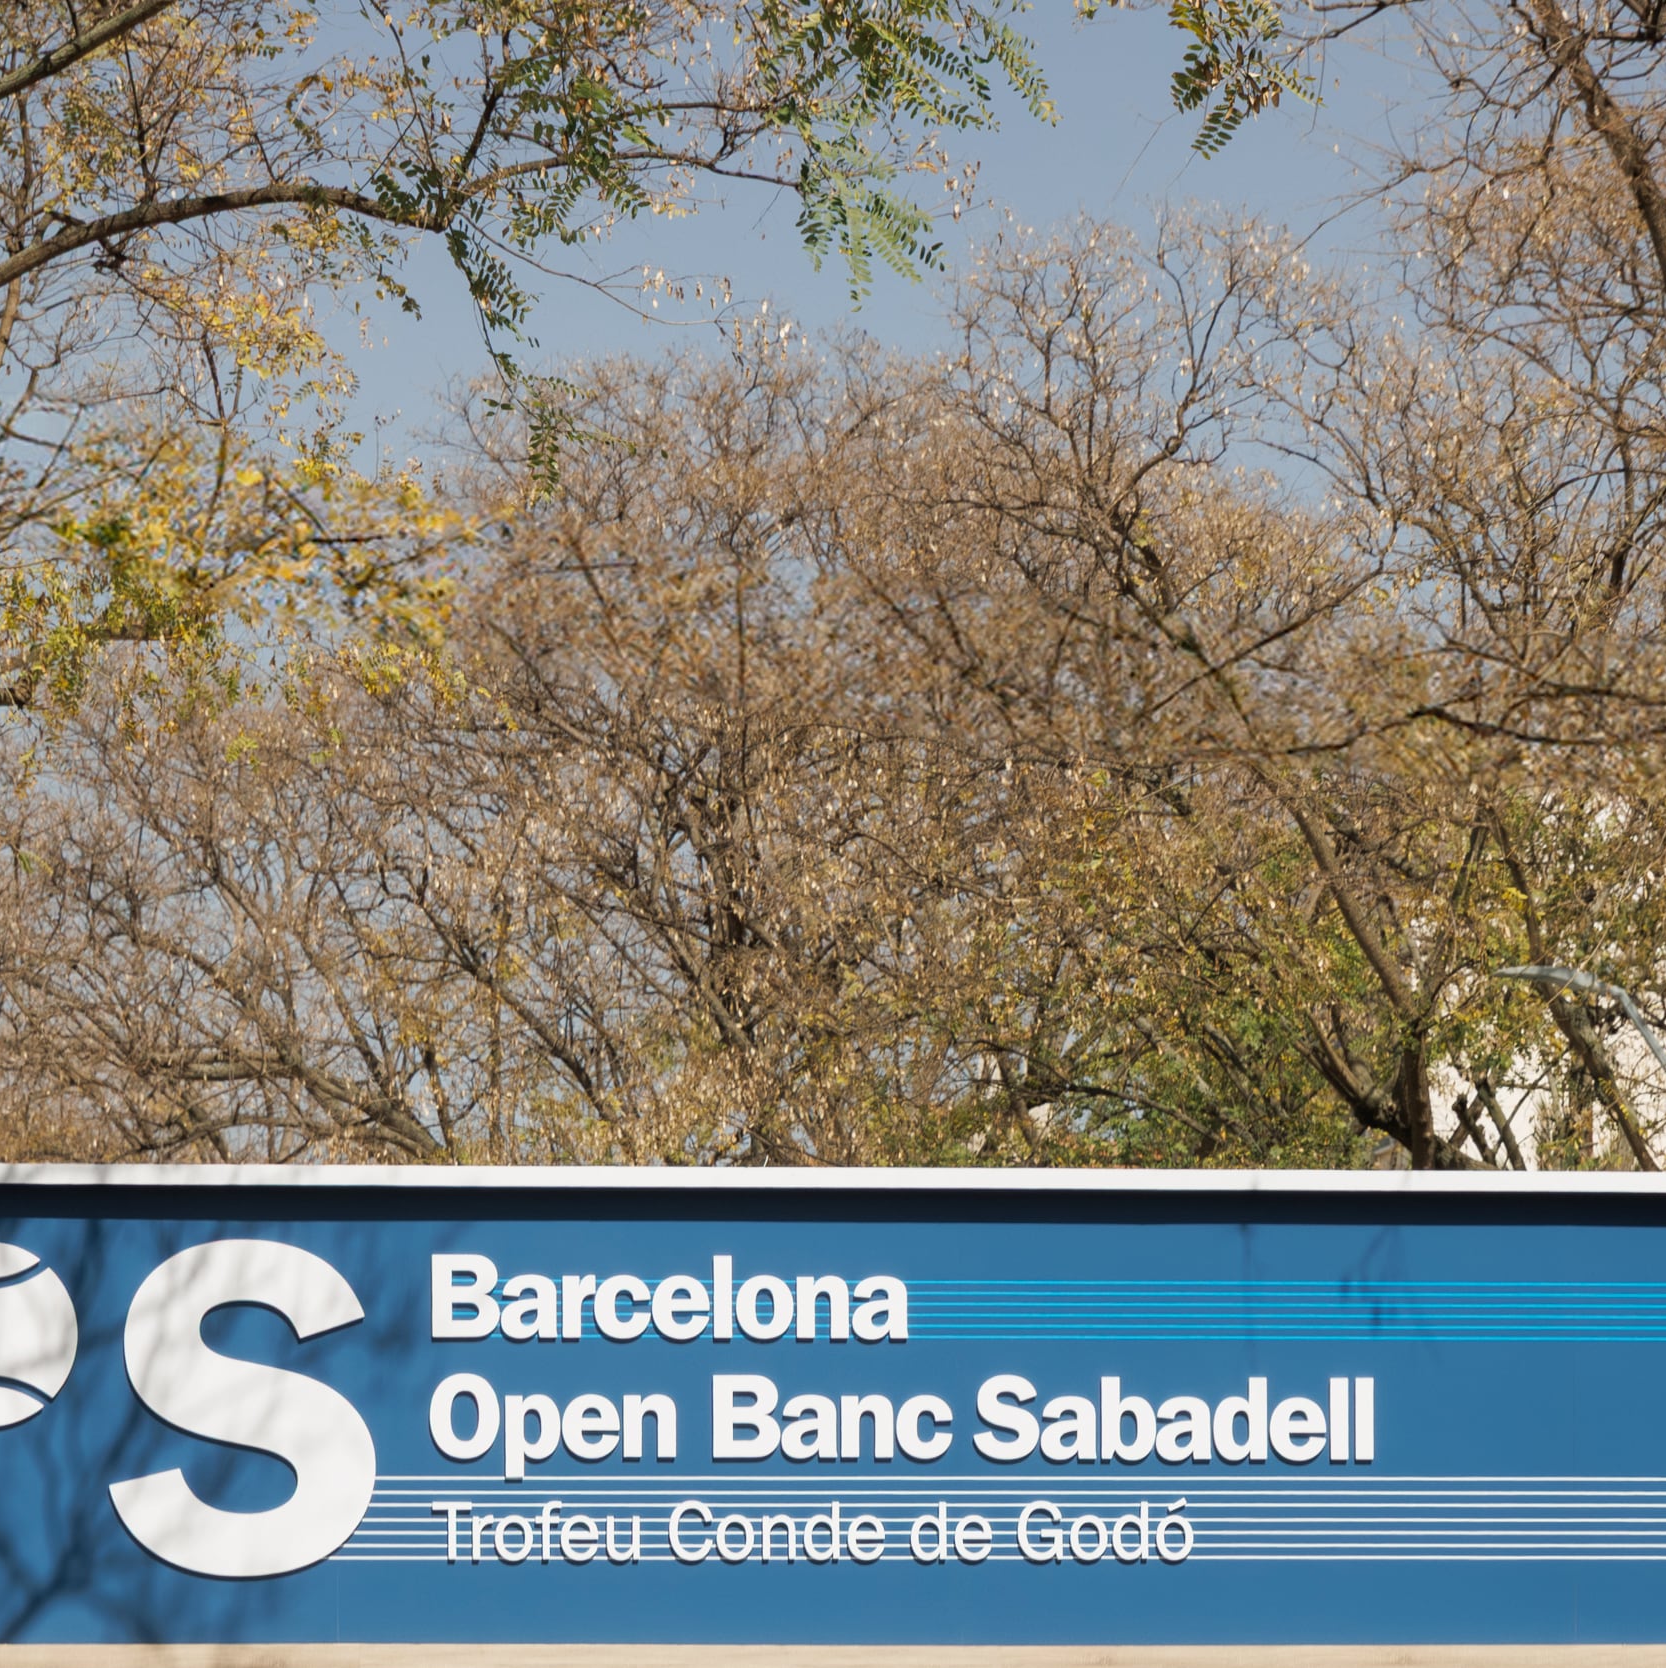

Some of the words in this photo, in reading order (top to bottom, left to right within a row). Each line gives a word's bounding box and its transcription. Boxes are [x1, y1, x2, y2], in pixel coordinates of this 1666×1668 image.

[431, 1253, 909, 1341] Barcelona
[430, 1373, 677, 1480] Open
[712, 1374, 953, 1460] Banc
[972, 1374, 1375, 1462] Sabadell
[433, 1501, 641, 1563] Trofeu
[669, 1500, 886, 1563] Conde
[910, 1501, 992, 1563] de
[1017, 1498, 1194, 1563] Godó
